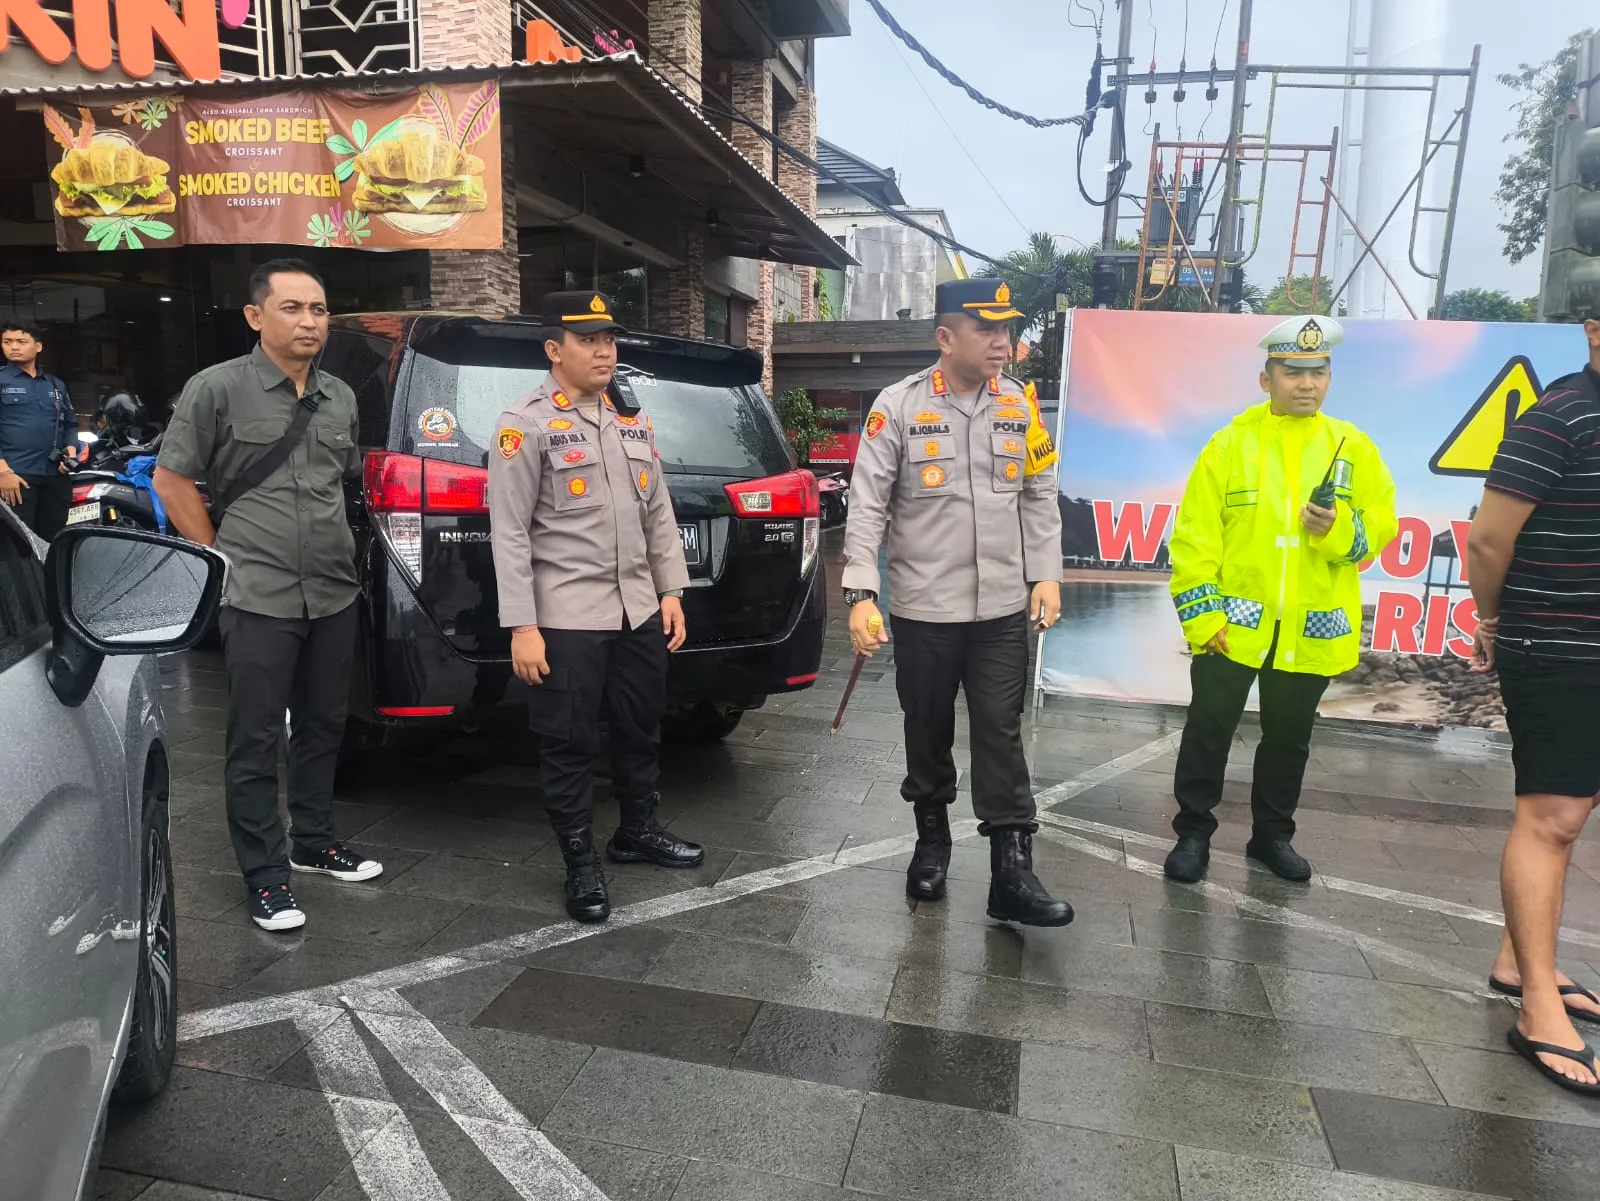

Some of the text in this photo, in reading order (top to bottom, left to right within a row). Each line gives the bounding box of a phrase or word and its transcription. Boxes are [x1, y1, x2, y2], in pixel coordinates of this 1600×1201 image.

[185, 117, 331, 145] SMOKED BEEF
[224, 147, 283, 157] CROISSANT
[178, 171, 341, 197] SMOKED CHICKEN
[226, 197, 282, 207] CROISSANT
[549, 434, 569, 448] AGUS
[619, 429, 649, 441] POLRI
[439, 531, 491, 542] INNOV
